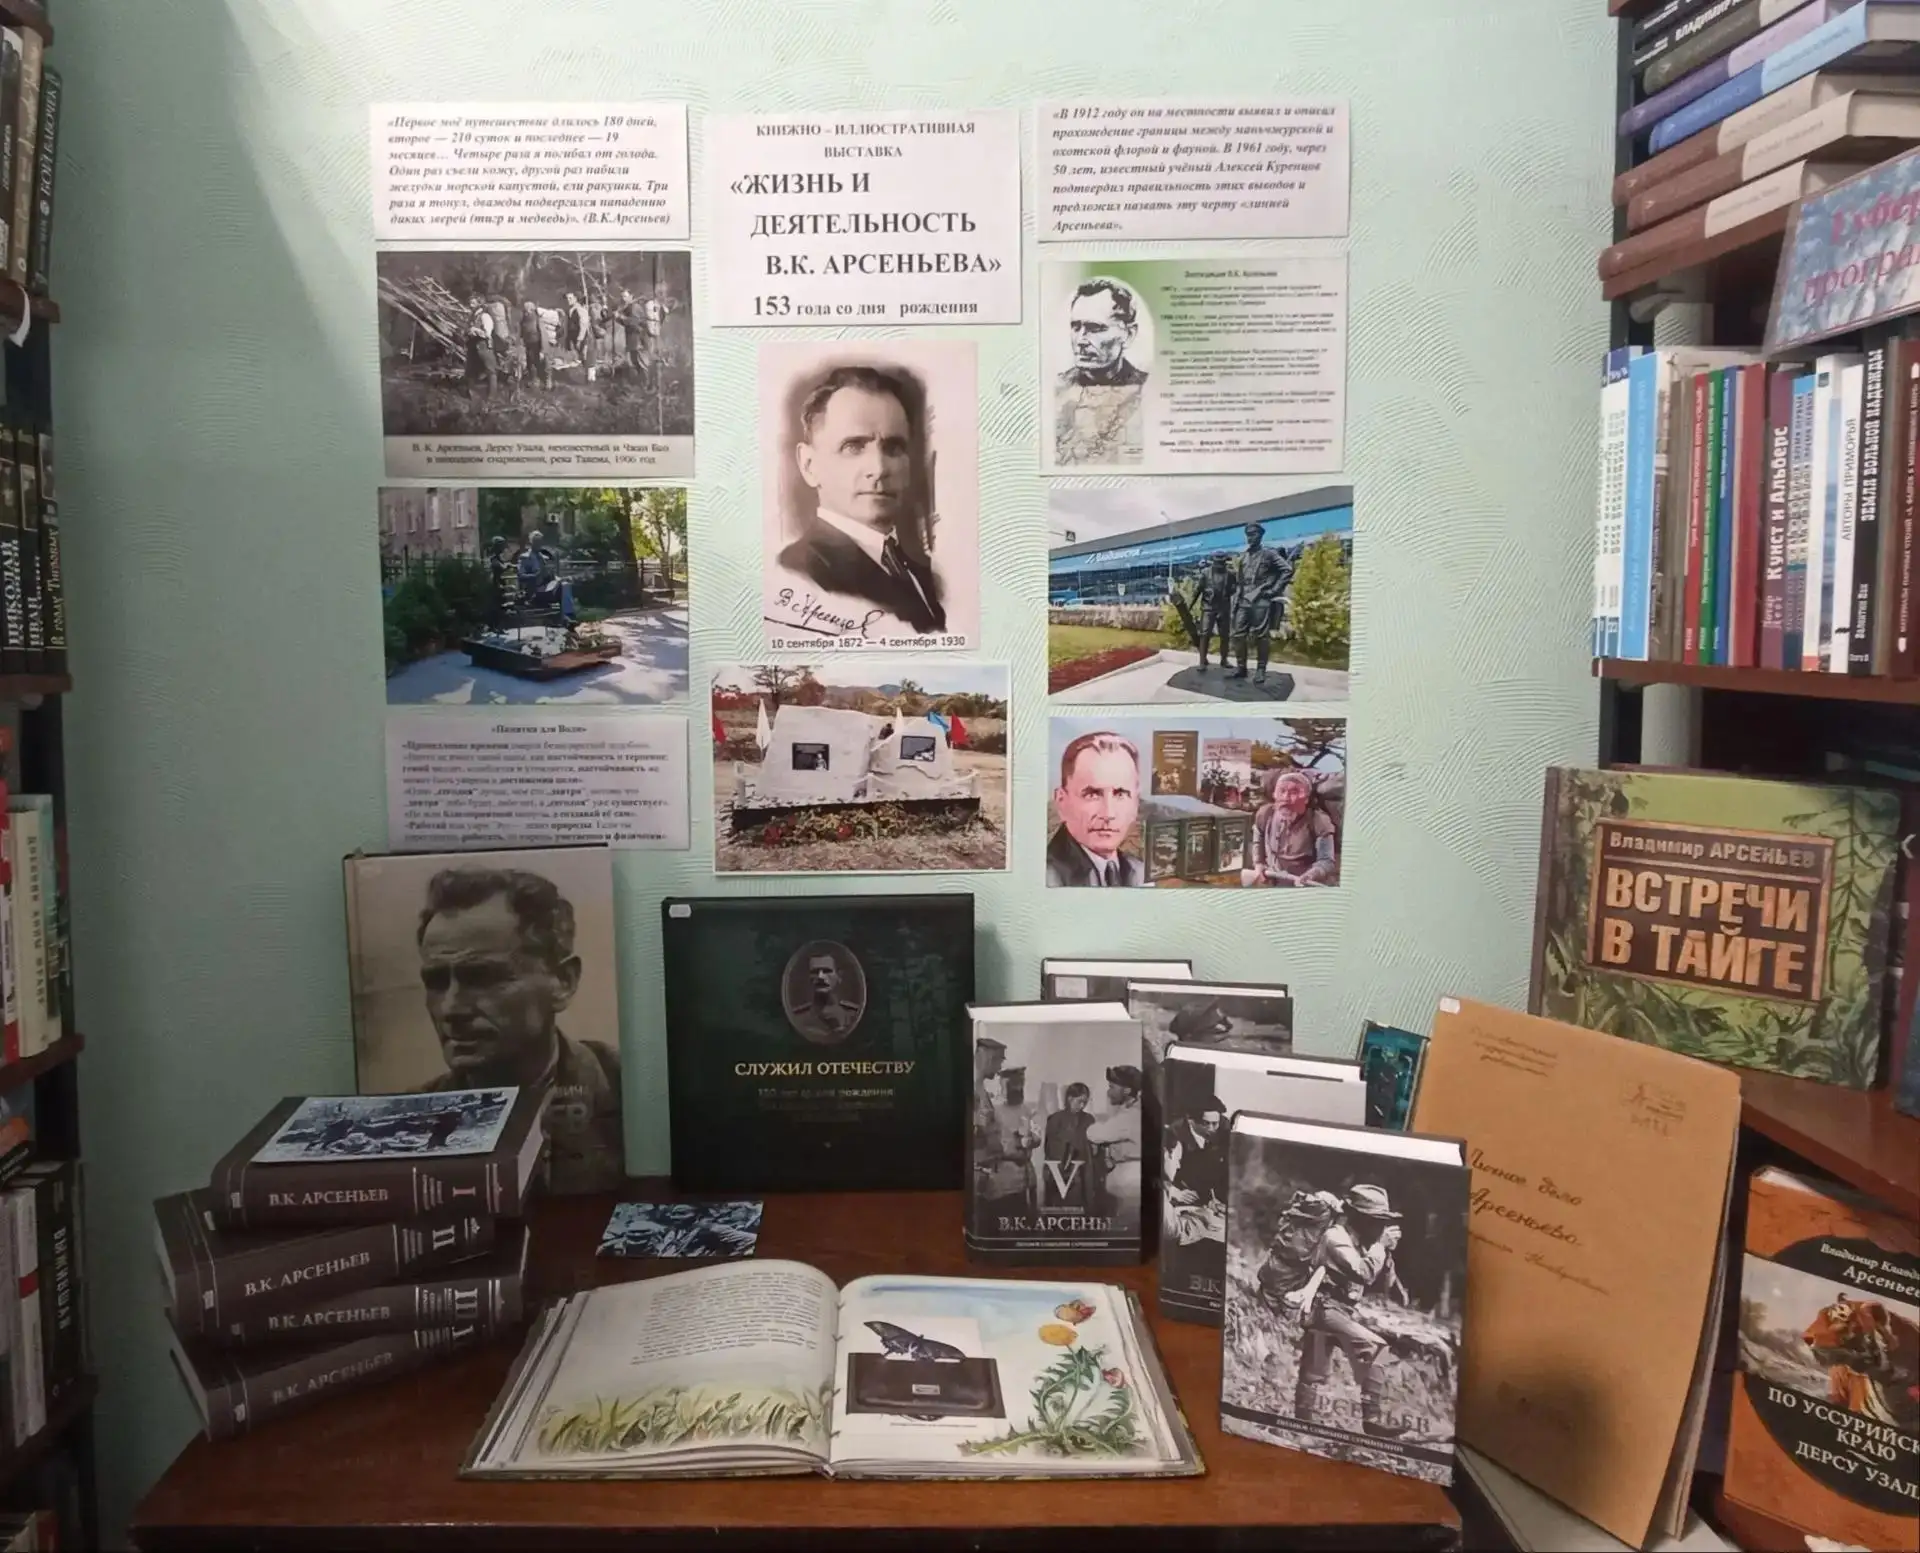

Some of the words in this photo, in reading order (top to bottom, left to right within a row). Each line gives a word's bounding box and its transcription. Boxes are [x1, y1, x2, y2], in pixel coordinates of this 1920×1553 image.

[463, 118, 549, 128] путешествие
[602, 115, 624, 126] 180
[1071, 106, 1100, 119] 1912
[1100, 107, 1128, 120] году
[1128, 109, 1145, 118] он
[1146, 108, 1163, 117] на
[1163, 107, 1236, 117] местности
[1282, 107, 1292, 116] и
[450, 131, 472, 143] 210
[473, 134, 511, 145] суток
[512, 134, 522, 142] и
[523, 132, 586, 143] последнее
[604, 131, 620, 142] 19
[756, 124, 821, 136] КНИЖНО
[834, 122, 975, 136] ИЛЛЮСТРАТИВНАЯ
[1051, 125, 1135, 140] прохождение
[1135, 126, 1188, 139] границы
[1189, 124, 1232, 137] между
[1324, 125, 1334, 134] и
[452, 147, 502, 162] Четыре
[502, 149, 531, 162] раза
[532, 150, 541, 158] я
[593, 149, 613, 158] от
[824, 146, 903, 158] ВЫСТАВКА
[1051, 147, 1111, 156] охотской
[1112, 143, 1160, 158] флорой
[1160, 146, 1170, 154] и
[1221, 141, 1233, 153] В
[1235, 141, 1262, 153] 1961
[1294, 144, 1327, 156] через
[388, 164, 420, 176] Один
[422, 167, 443, 178] раз
[520, 164, 561, 177] другой
[561, 165, 583, 177] раз
[584, 163, 630, 175] набили
[1051, 163, 1069, 175] 50
[1098, 162, 1166, 174] известный
[1166, 161, 1212, 175] учёный
[1213, 160, 1264, 172] Алексей
[1264, 158, 1321, 174] Куренцов
[445, 182, 496, 194] морской
[561, 182, 584, 191] ели
[645, 179, 668, 194] Три
[730, 173, 843, 196] «ЖИЗНЬ
[852, 172, 870, 193] И
[1051, 182, 1125, 196] подтвердил
[1126, 182, 1212, 195] правильность
[1212, 181, 1246, 191] этих
[1246, 179, 1296, 190] выводов
[1297, 180, 1306, 190] и
[387, 199, 416, 210] раза
[417, 199, 426, 208] я
[471, 196, 522, 207] дважды
[523, 196, 597, 210] подвергался
[598, 196, 666, 207] нападению
[1051, 201, 1122, 216] предложил
[1122, 201, 1173, 210] назвать
[1175, 201, 1199, 212] эту
[1200, 200, 1238, 212] черту
[389, 213, 425, 224] диких
[468, 213, 505, 226] (тигр
[506, 215, 515, 223] и
[750, 212, 976, 238] ДЕЯТЕЛЬНОСТЬ
[766, 255, 815, 275] В.К.
[822, 253, 1002, 275] АРСЕНЬЕВА»
[753, 296, 791, 316] 153
[797, 304, 831, 317] года
[836, 304, 852, 315] со
[856, 303, 886, 317] дня
[900, 302, 978, 318] рождения
[1865, 349, 1885, 418] НАДЕЖДЫ
[1843, 417, 1857, 488] ПРИМОРЬЯ
[1862, 420, 1881, 475] ВОЛЬНОЙ
[1770, 425, 1789, 503] Альберс
[1860, 479, 1877, 522] ЗЕМЛЯ
[1771, 509, 1785, 521] и
[1842, 492, 1854, 541] АВТОРЫ
[1766, 526, 1785, 581] Кунст
[1855, 600, 1867, 639] Валентин
[772, 639, 783, 648] 10
[786, 638, 834, 650] сентября
[838, 638, 863, 647] 1872
[880, 637, 886, 647] 4
[889, 636, 937, 648] сентября
[941, 636, 965, 646] 1930
[1609, 831, 1704, 861] Владимир
[1709, 843, 1815, 869] АРСЕНЬЕВ
[1604, 867, 1811, 933] ВСТРЕЧИ
[1601, 918, 1634, 965] В
[1651, 921, 1807, 993] ТАЙГЕ
[734, 1062, 813, 1076] СЛУЖИЛ
[817, 1060, 916, 1075] ОТЕЧЕСТВУ
[1044, 1160, 1085, 1201] V
[1537, 1175, 1584, 1207] дело
[302, 1188, 389, 1205] АРСЕНЬЕВ
[998, 1216, 1031, 1231] В.К.
[1820, 1242, 1878, 1270] Владимир
[53, 1226, 72, 1331] ВЫЖИВШАЯ
[281, 1251, 371, 1289] АРСЕНЬЕВ
[302, 1306, 391, 1328] АРСЕНЬЕВ
[306, 1352, 394, 1392] АРСЕНЬЕВ
[1768, 1387, 1797, 1409] ПО
[1837, 1429, 1897, 1462] КРАЮ
[1795, 1441, 1859, 1475] ДЕРСУ
[1865, 1467, 1920, 1501] УЗАЛ
